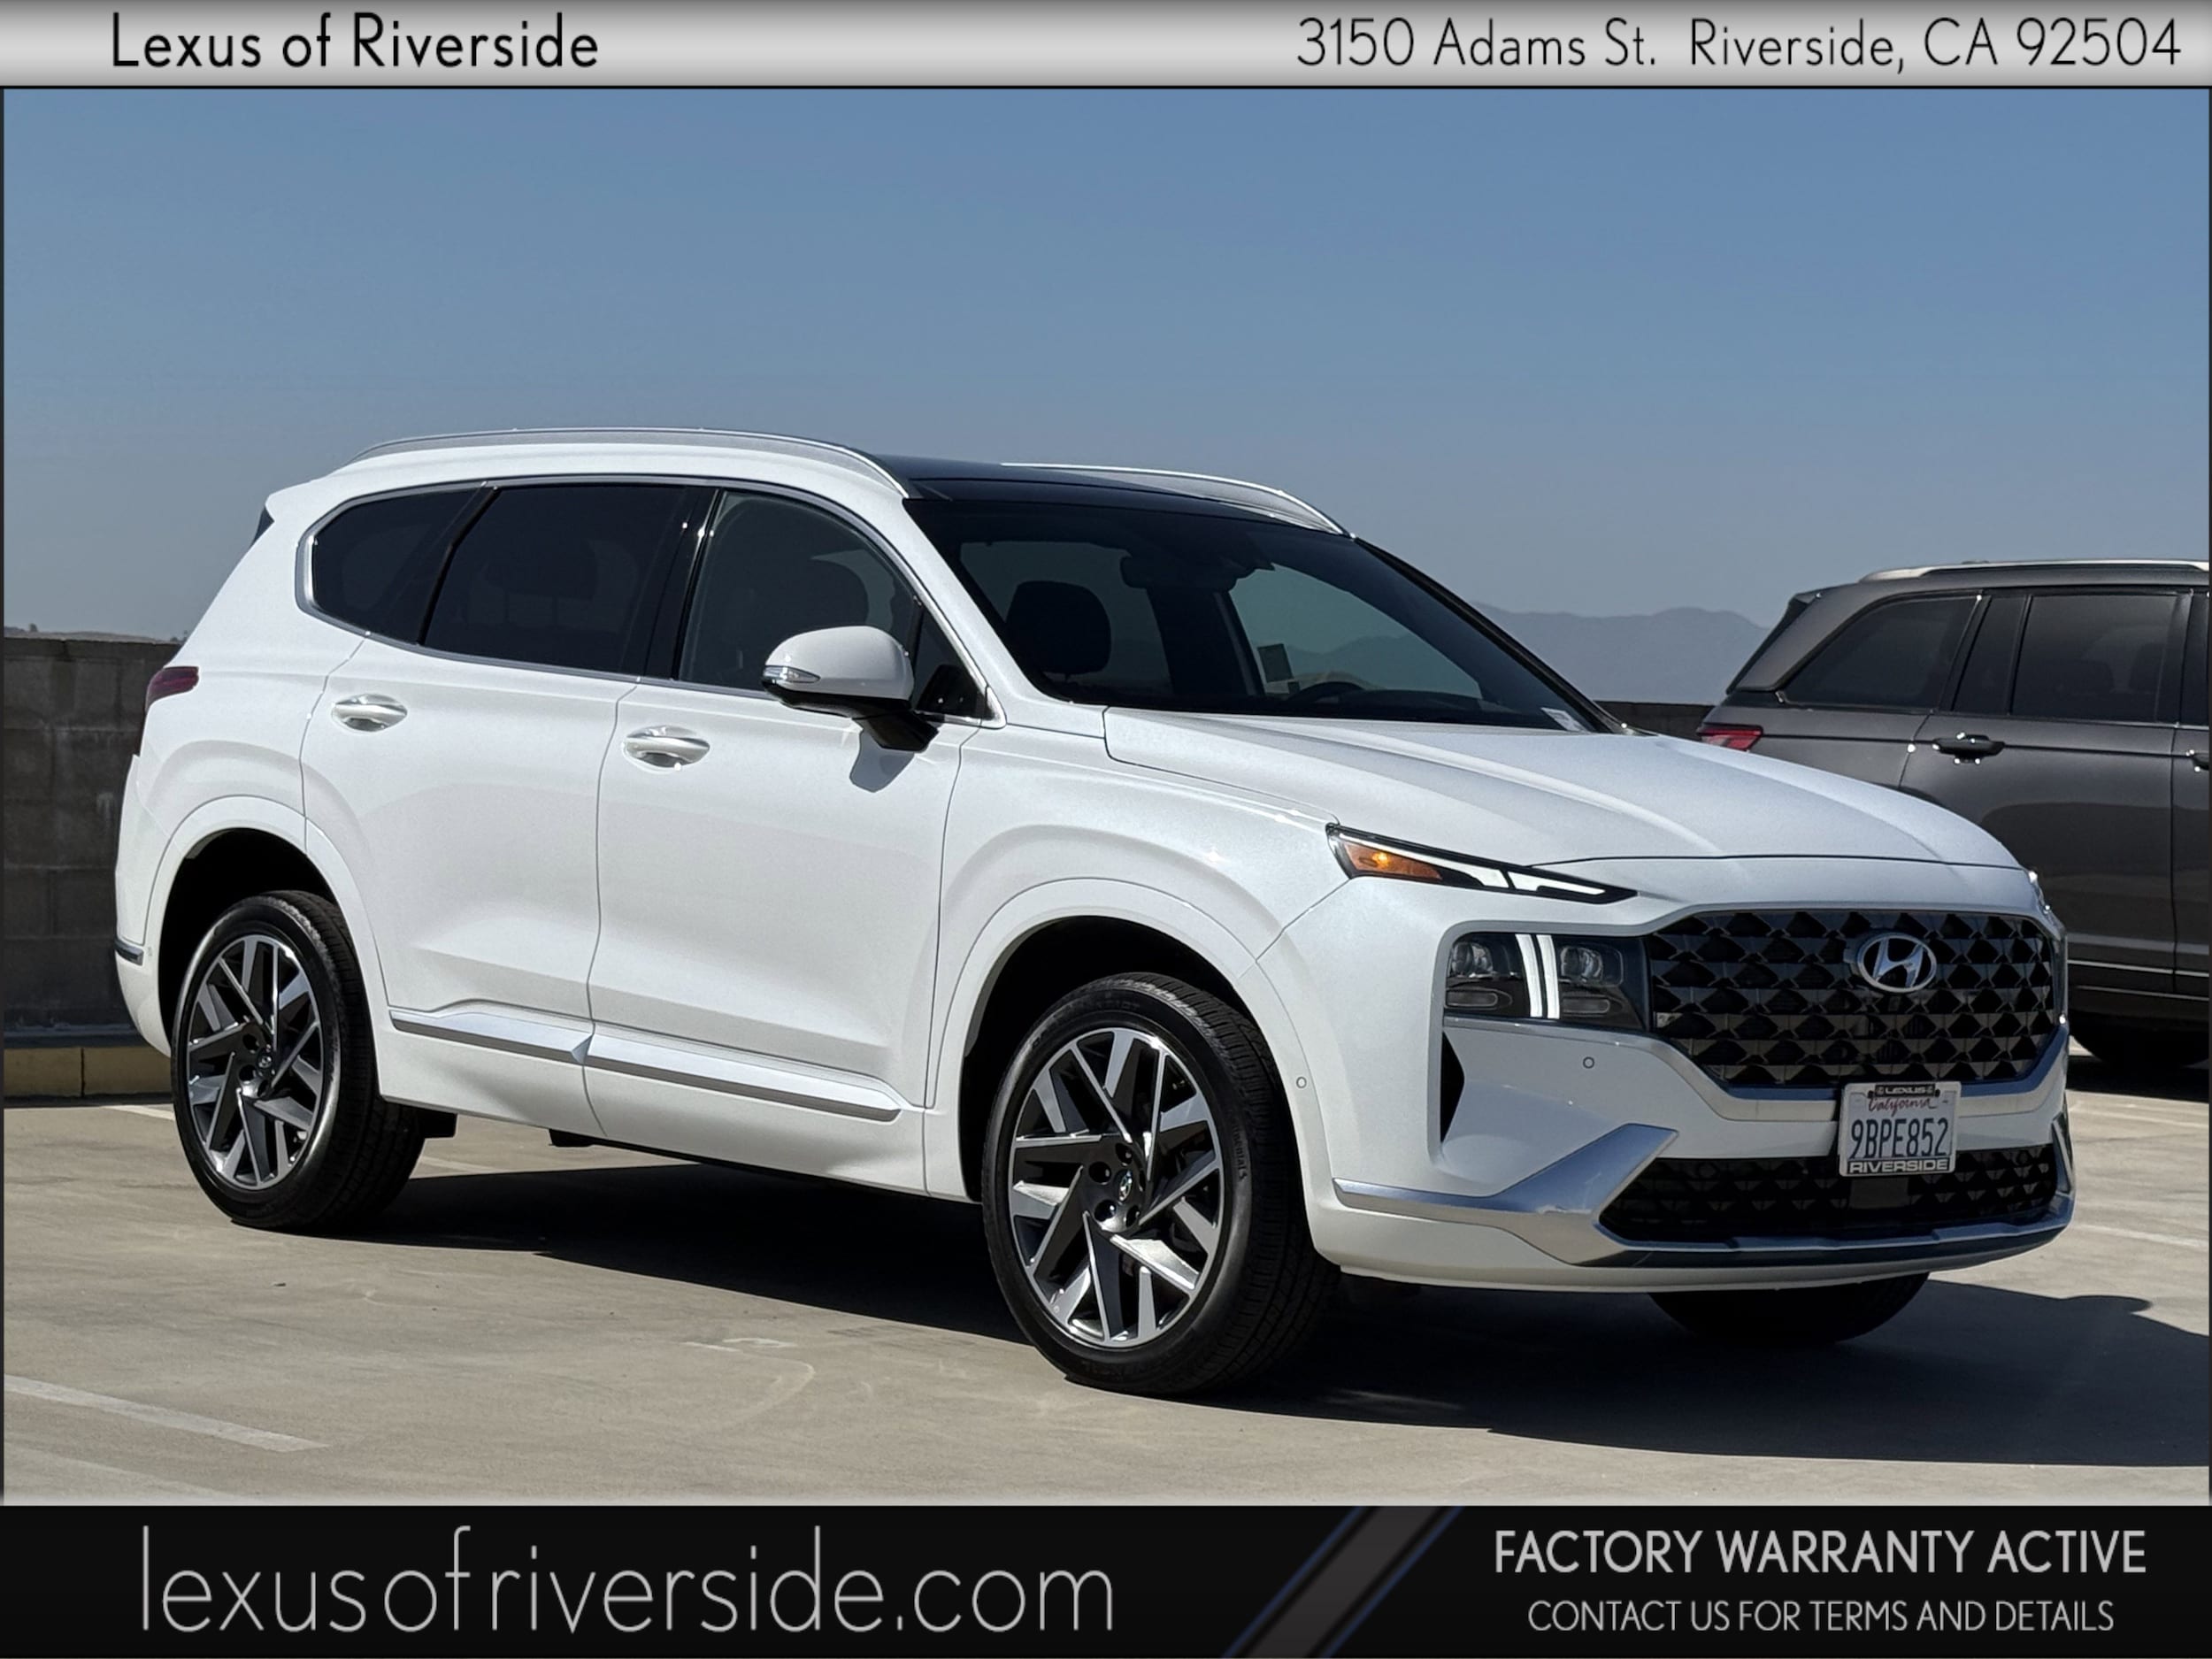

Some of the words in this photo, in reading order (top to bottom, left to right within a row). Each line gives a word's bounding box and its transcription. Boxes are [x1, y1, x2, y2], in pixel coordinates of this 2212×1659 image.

[1868, 1097, 1938, 1118] California
[1849, 1118, 1949, 1160] 9BPE852
[1849, 1159, 1949, 1174] RIVERSIDE
